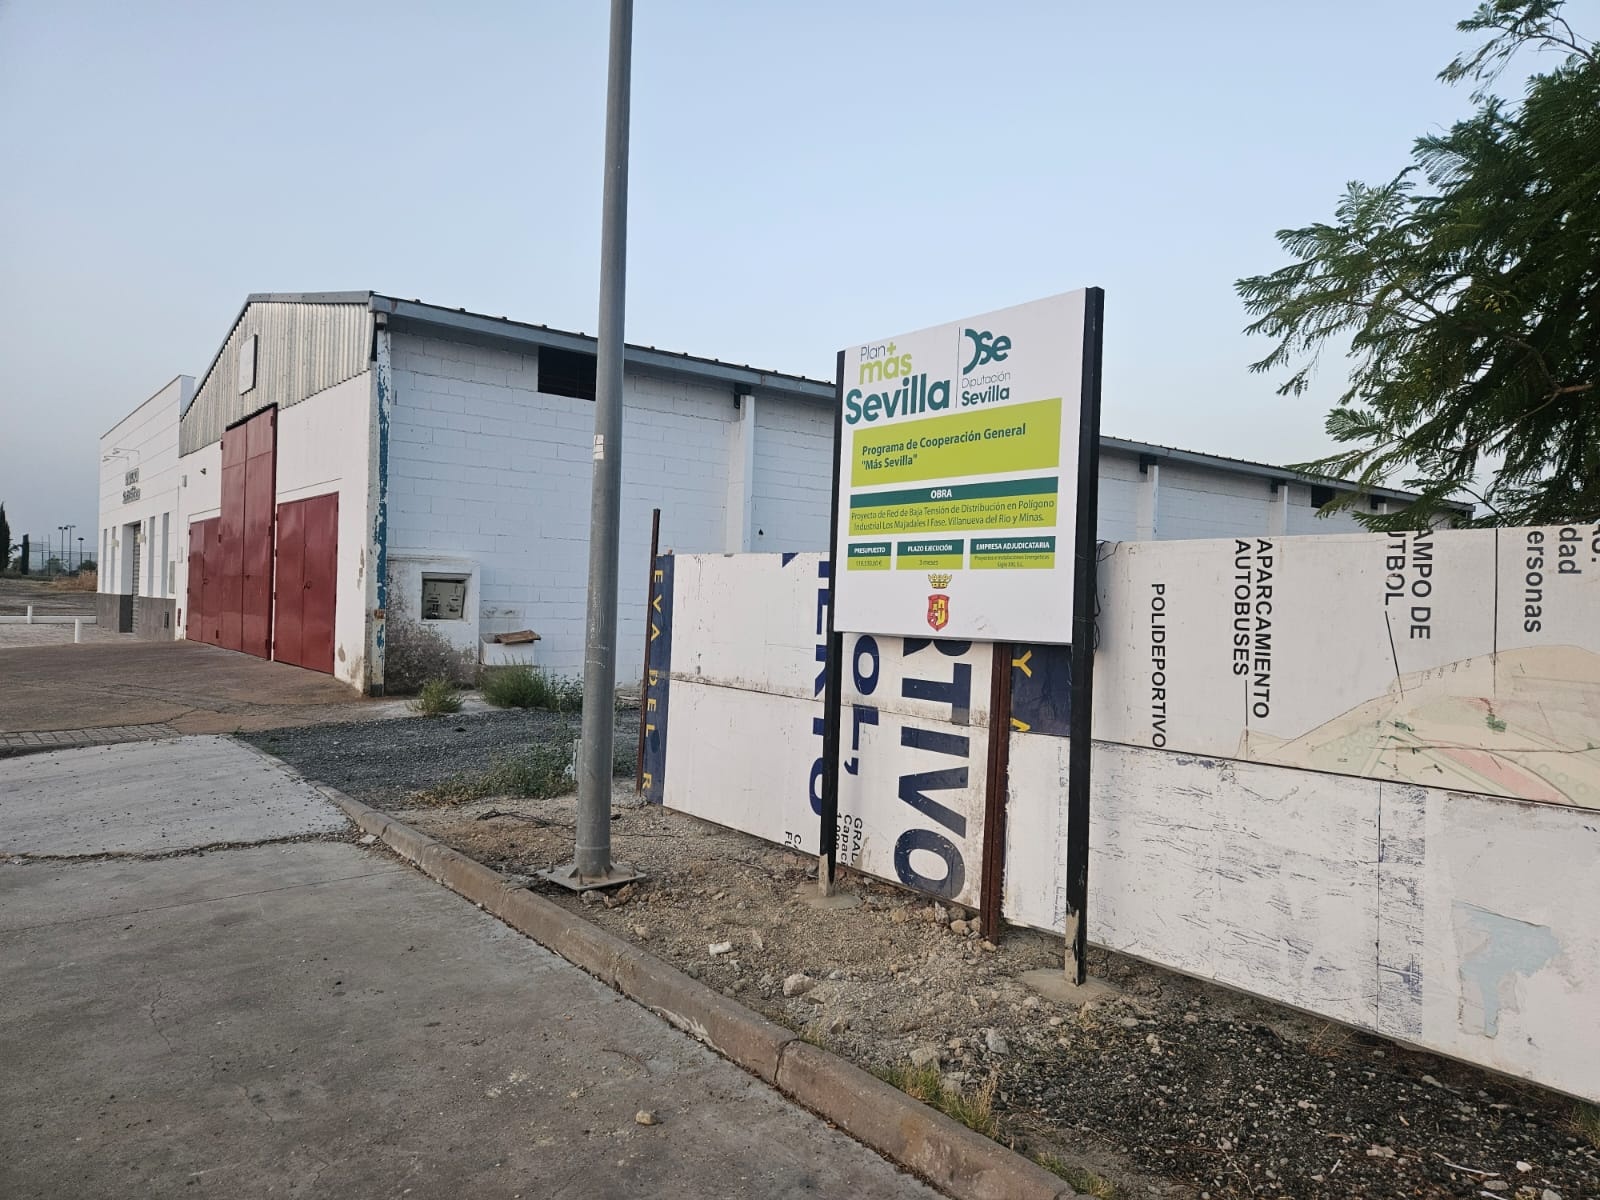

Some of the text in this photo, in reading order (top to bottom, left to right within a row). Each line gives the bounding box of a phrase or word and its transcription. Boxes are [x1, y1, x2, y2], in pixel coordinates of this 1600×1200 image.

[962, 371, 1011, 389] Diputación
[845, 373, 950, 425] Sevilla
[961, 386, 1010, 407] Sevilla
[862, 423, 1026, 457] Programa de Cooperación General
[930, 489, 953, 499] OBRA
[851, 500, 1055, 522] Proyecto de Red de Baja Tensión de Distribución en Polígono
[854, 520, 882, 531] Industrial
[882, 520, 893, 530] Los
[948, 515, 984, 526] Villanueva
[985, 514, 998, 524] del
[1012, 515, 1018, 525] y
[853, 546, 886, 554] PRESUPUESTO
[975, 541, 1050, 551] EMPRESA ADJUDICATARIA
[1232, 539, 1251, 676] AUTOBUSES
[1252, 538, 1273, 719] APARCAMIENTO
[1409, 606, 1432, 640] DE
[1151, 583, 1167, 748] POLIDEPORTIVO
[894, 638, 973, 901] TIVO
